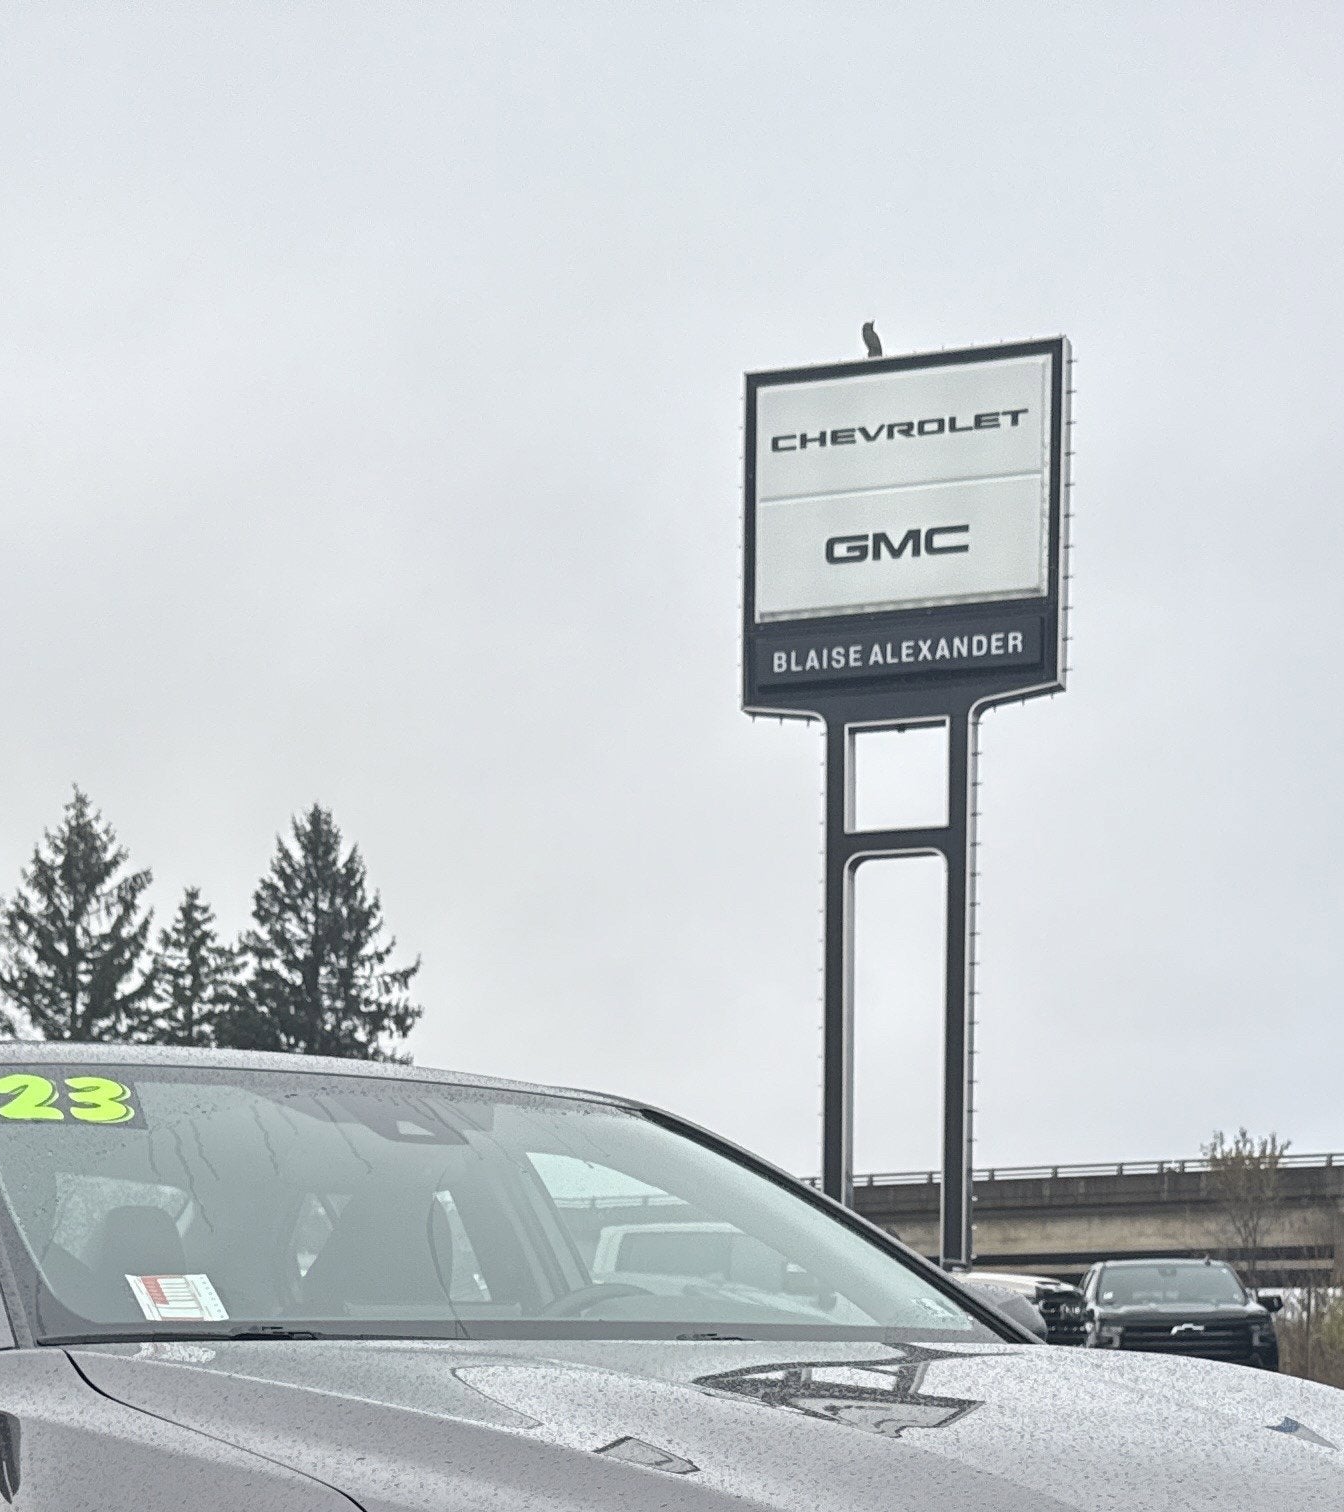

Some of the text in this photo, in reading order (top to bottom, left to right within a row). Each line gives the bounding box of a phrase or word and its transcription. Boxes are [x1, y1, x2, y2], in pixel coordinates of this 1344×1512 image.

[770, 408, 1029, 452] CHEVROLET
[825, 524, 970, 565] GMC
[772, 631, 1024, 673] BLAISE ALEXANDER
